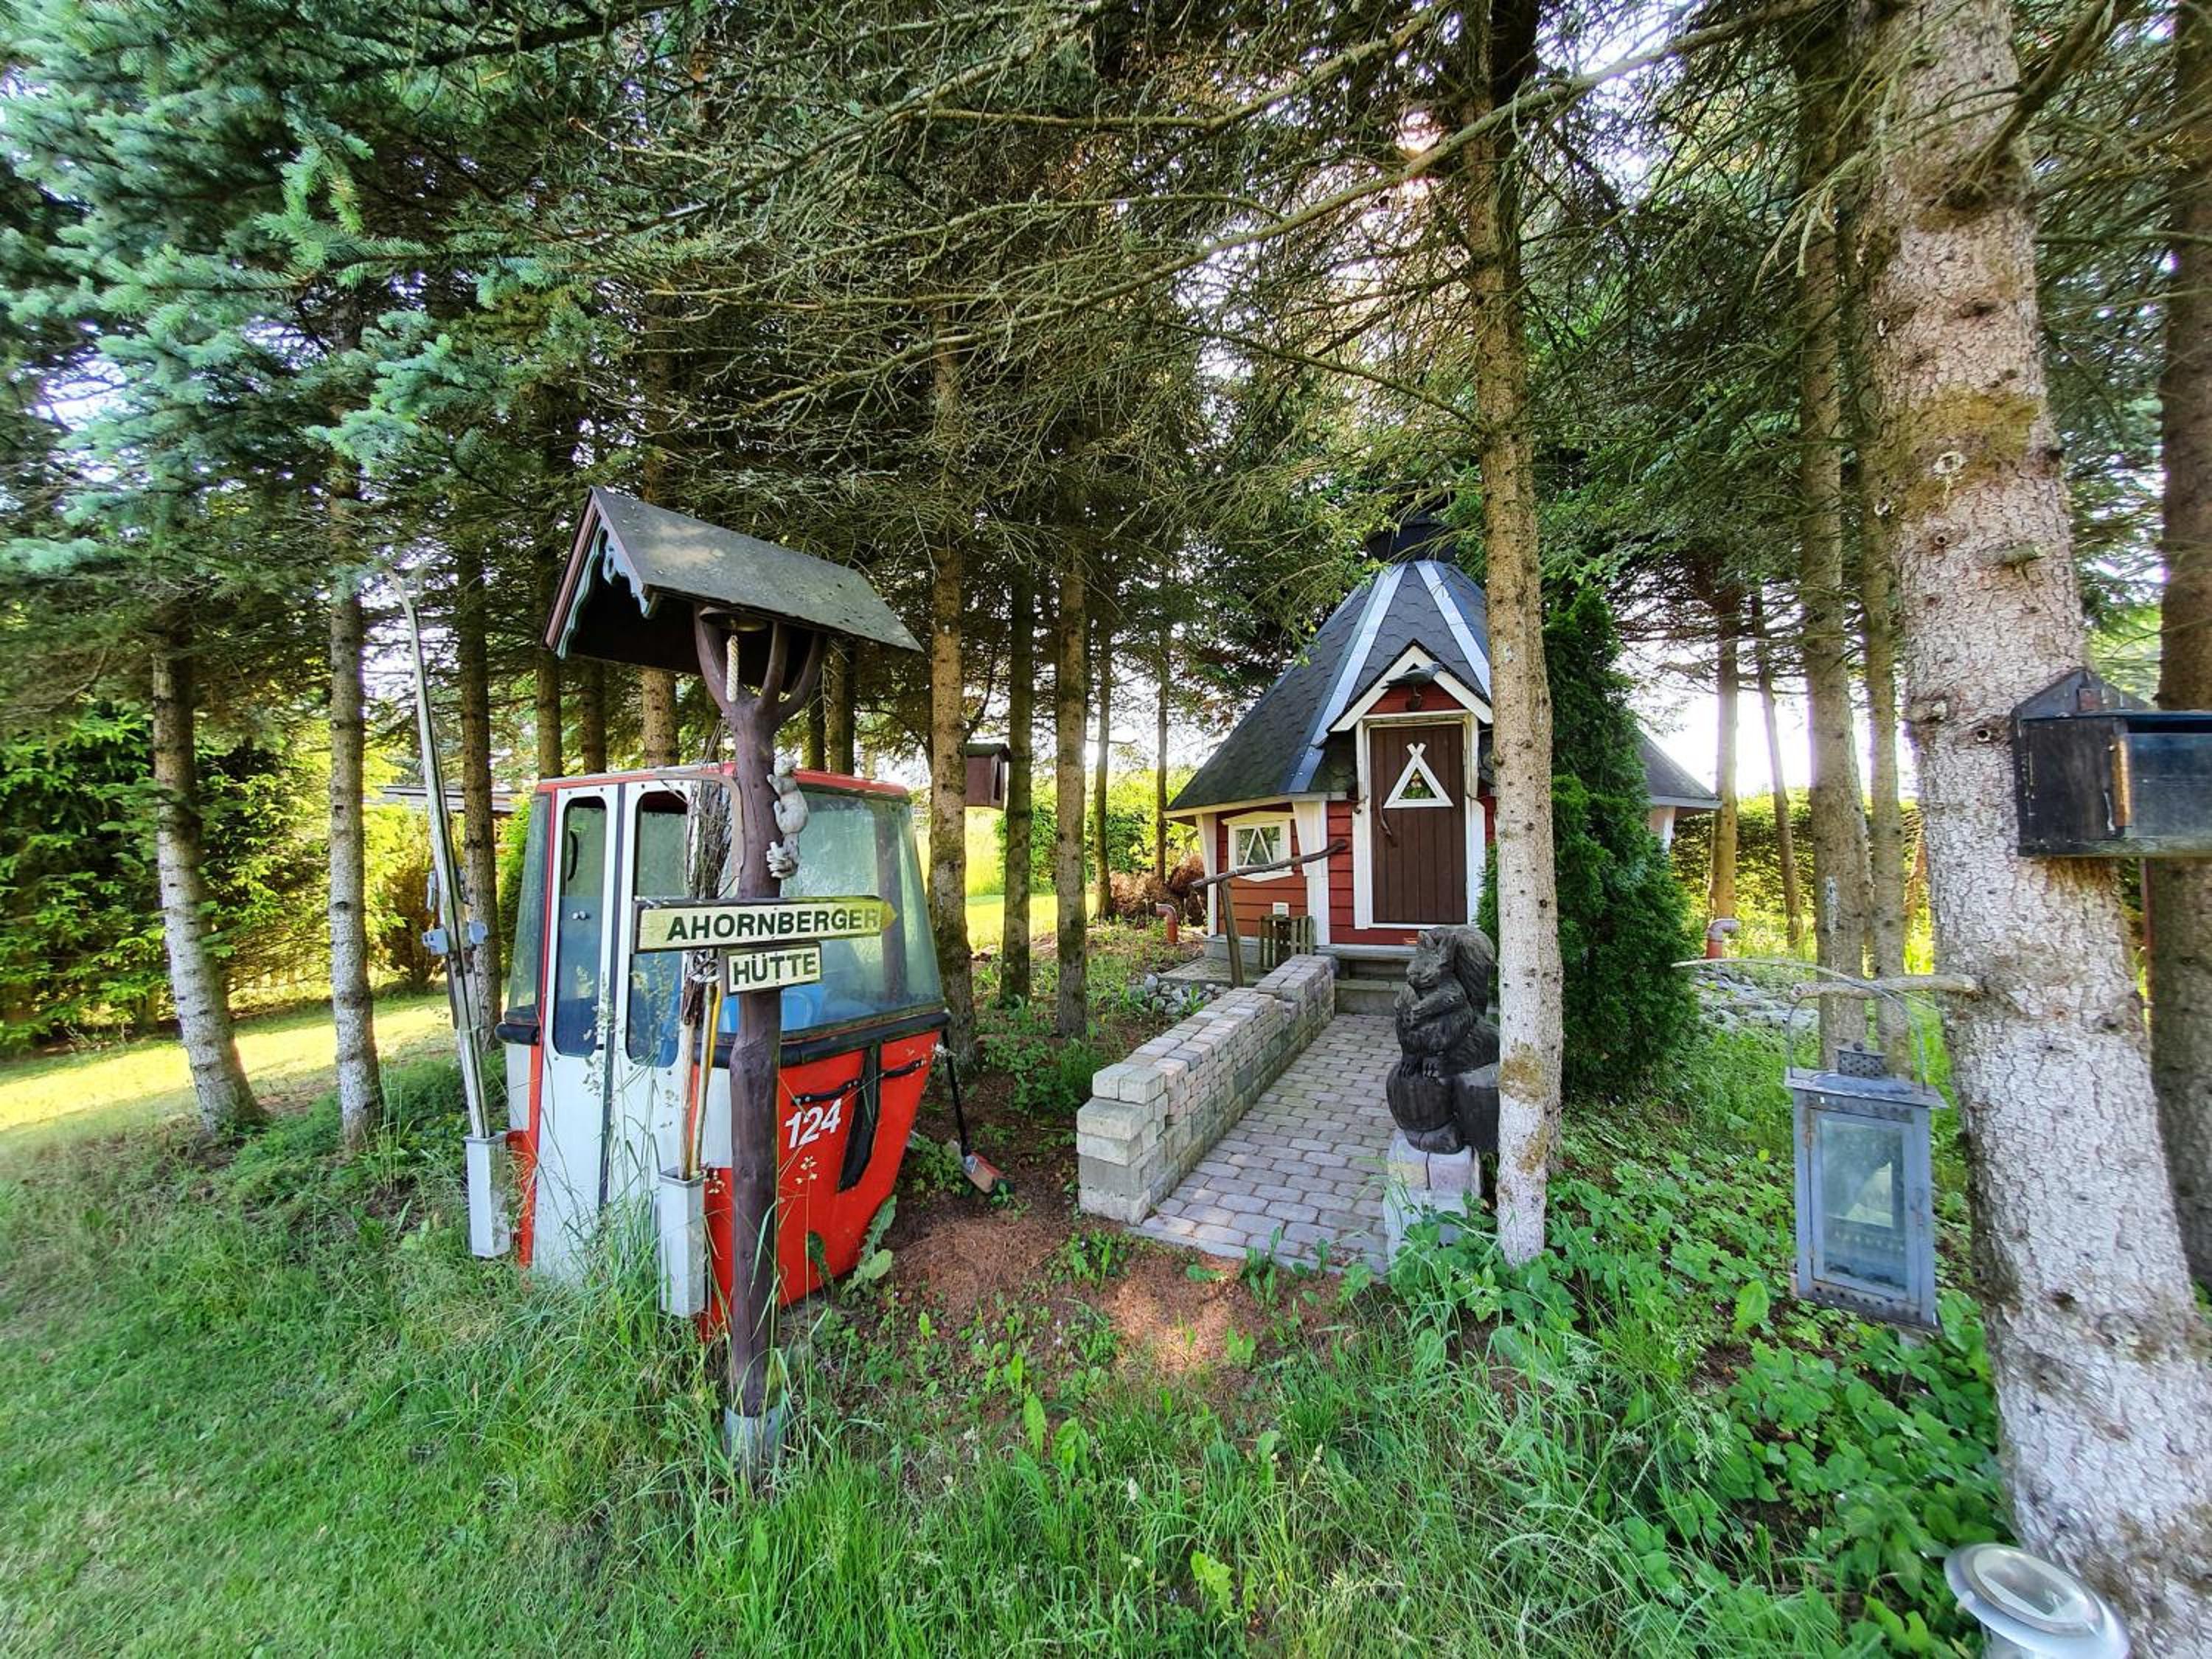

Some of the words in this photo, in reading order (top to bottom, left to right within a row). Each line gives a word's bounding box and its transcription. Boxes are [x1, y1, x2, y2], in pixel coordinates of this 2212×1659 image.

[667, 908, 879, 942] AHORNBERGER
[734, 953, 817, 985] HÜTTE
[785, 1099, 842, 1149] 124
